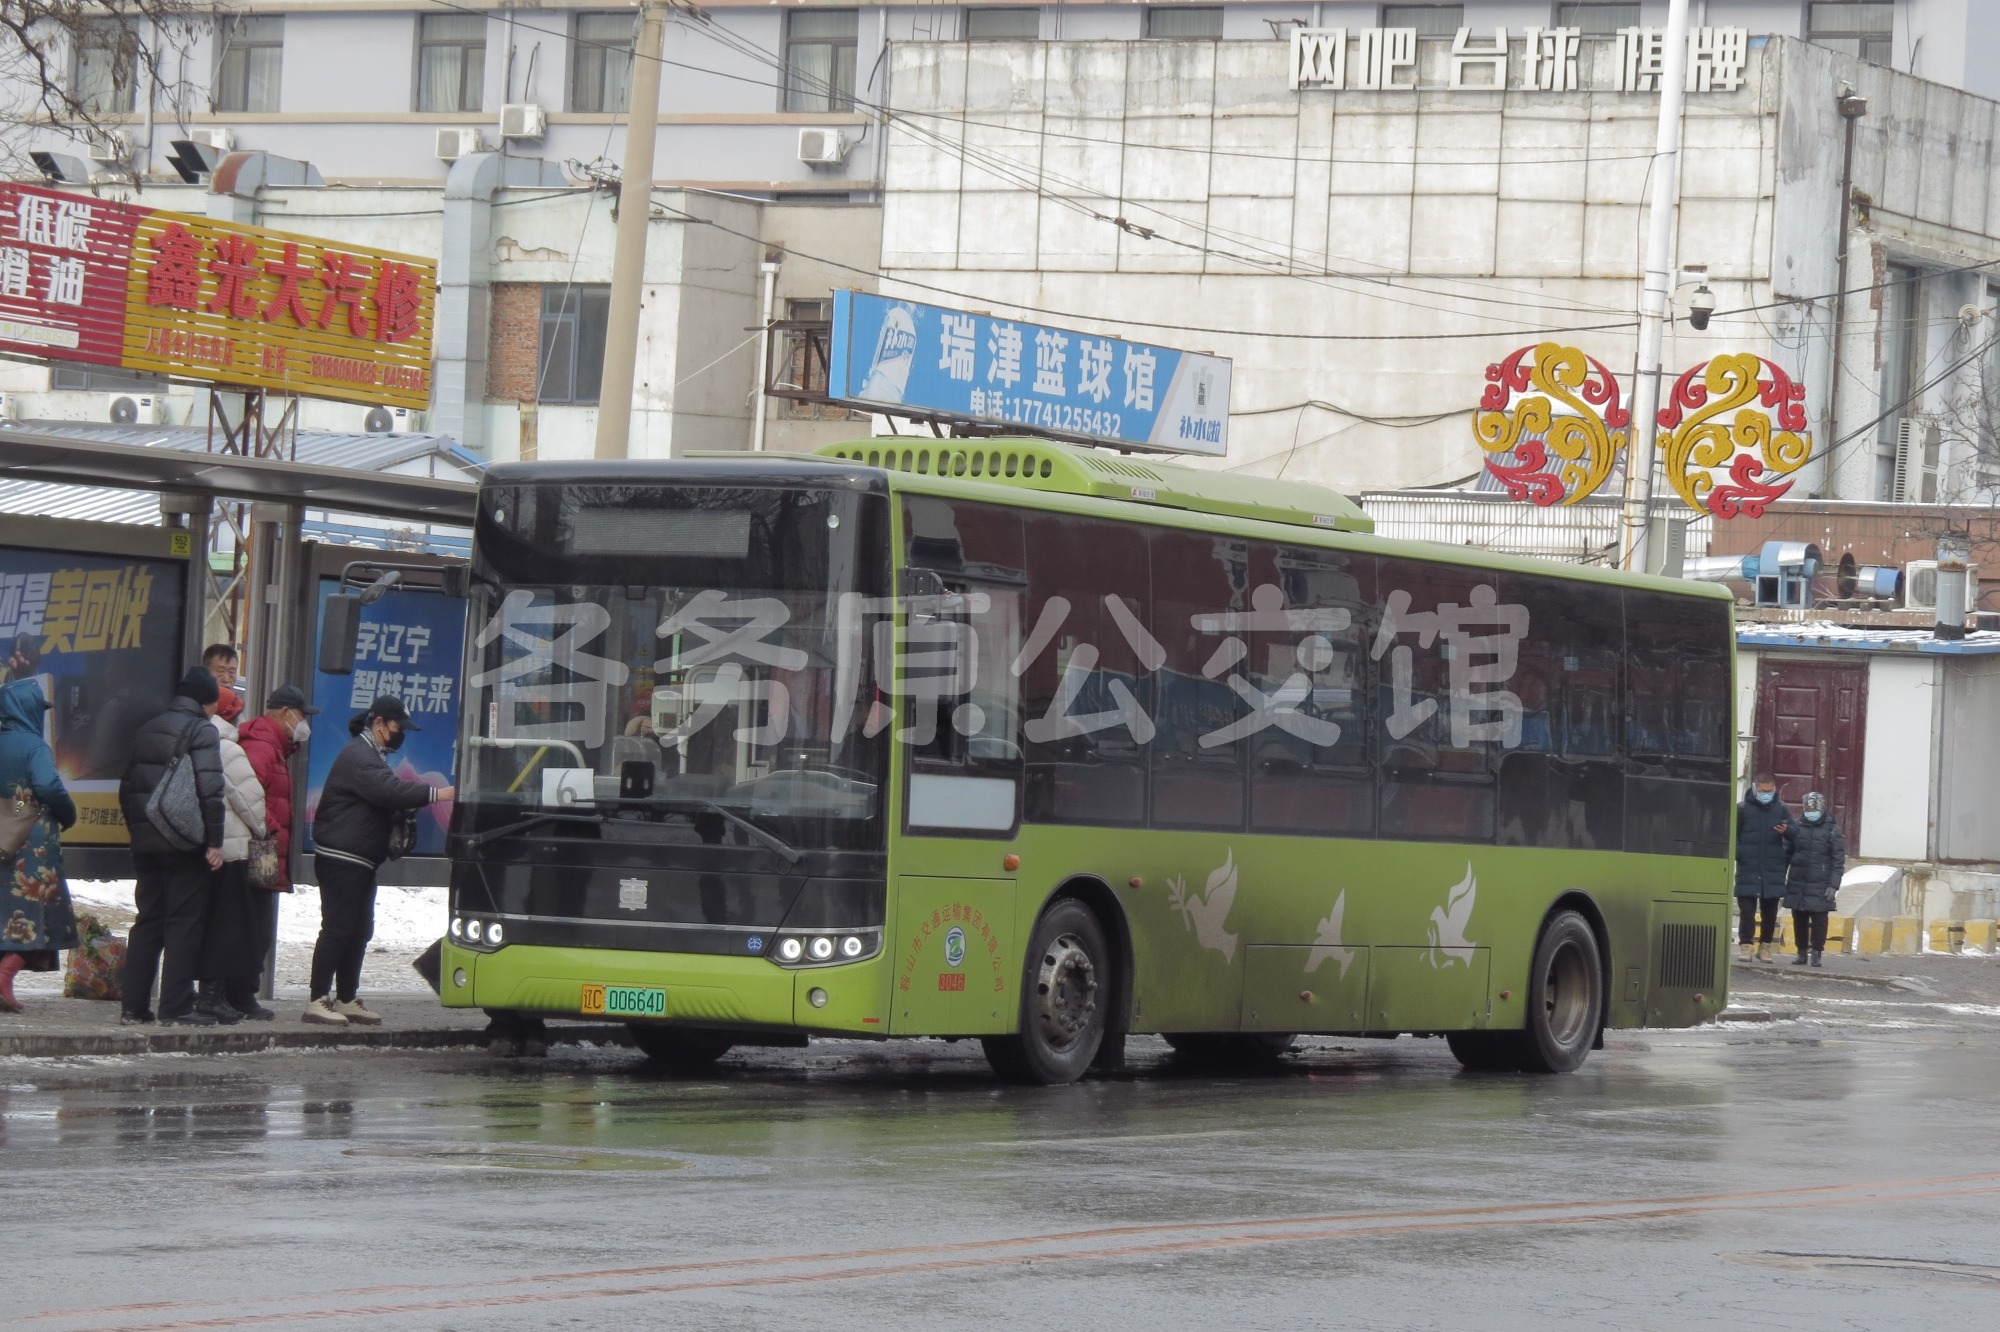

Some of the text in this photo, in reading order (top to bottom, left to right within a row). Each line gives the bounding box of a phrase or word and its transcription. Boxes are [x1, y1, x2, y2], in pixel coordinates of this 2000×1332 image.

[1290, 26, 1749, 92] 网吧 台球 棋牌
[148, 222, 422, 344] 鑫光大汽修
[938, 314, 1157, 412] 瑞津篮球馆
[1180, 415, 1221, 442] 补水啦
[556, 769, 577, 807] 6
[940, 974, 964, 990] 3046
